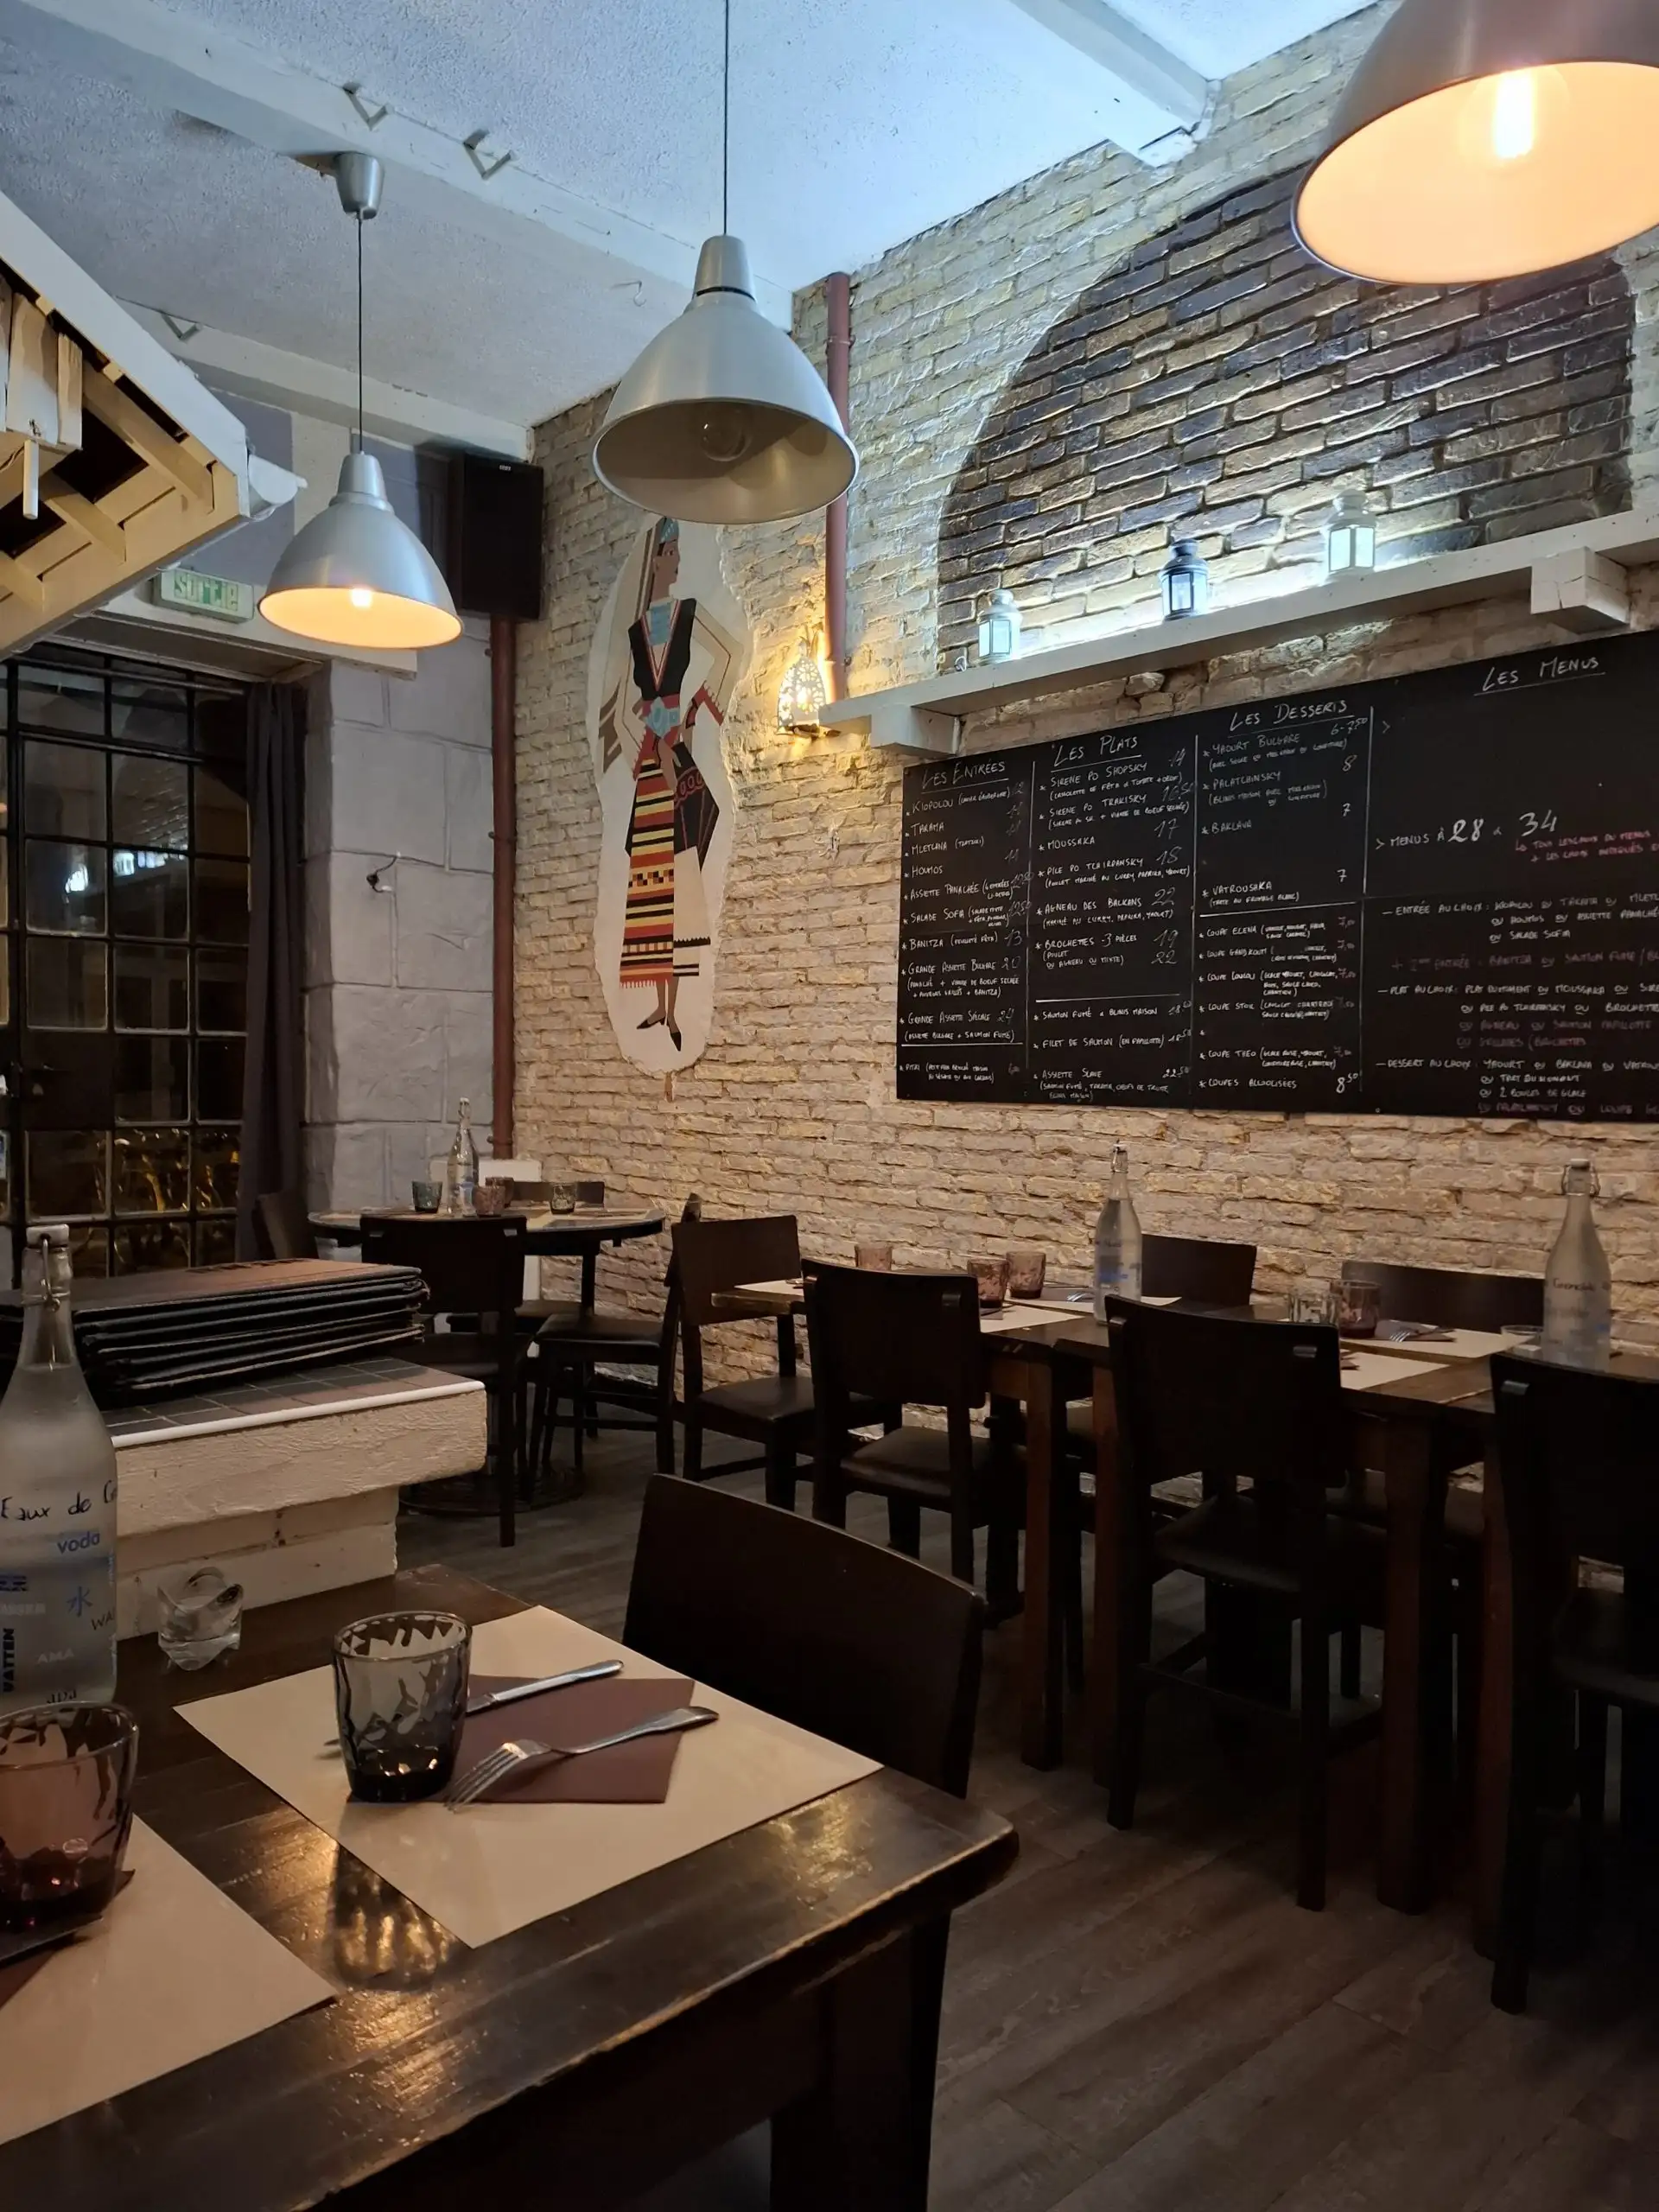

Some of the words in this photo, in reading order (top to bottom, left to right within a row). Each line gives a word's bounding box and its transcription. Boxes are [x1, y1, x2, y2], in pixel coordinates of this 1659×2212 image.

[1483, 667, 1518, 691] LES
[1540, 657, 1599, 677] MENUS
[1230, 713, 1260, 731] LES
[1274, 700, 1347, 723] DESSERTS
[1054, 746, 1084, 766] LES
[1100, 735, 1138, 755] PLATS
[923, 769, 946, 789] LES
[953, 759, 1005, 785] ENTRÉES
[1106, 763, 1147, 778] SHOPSKY
[1211, 820, 1251, 833] BAKLAVA
[1390, 834, 1429, 846] MENUS
[1448, 818, 1484, 842] 28
[1519, 810, 1557, 836] 34
[1047, 836, 1095, 849] MOUSSAKA
[1045, 904, 1077, 915] AGNEAU
[910, 939, 943, 950] BANITZA
[1045, 938, 1095, 950] BROCHETTES
[1043, 1039, 1065, 1048] FILET
[67, 1491, 92, 1516] de
[57, 1530, 101, 1554] voda
[66, 1585, 93, 1618] 水
